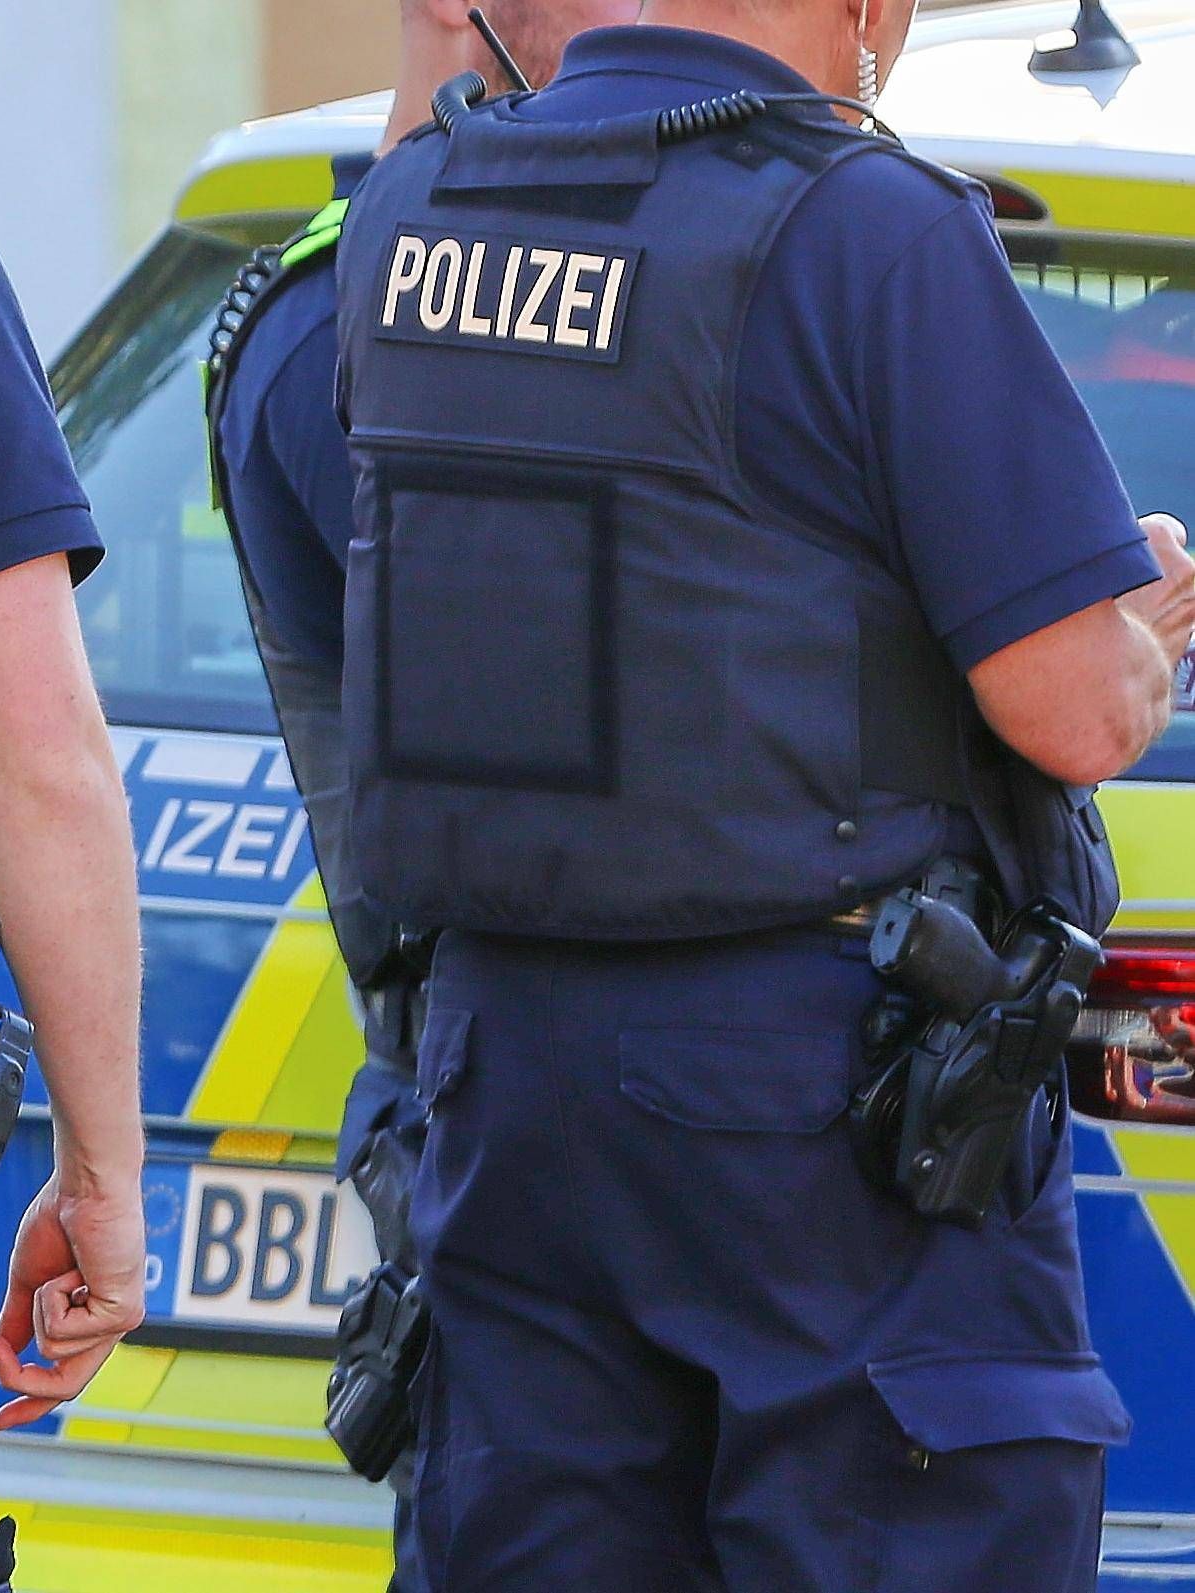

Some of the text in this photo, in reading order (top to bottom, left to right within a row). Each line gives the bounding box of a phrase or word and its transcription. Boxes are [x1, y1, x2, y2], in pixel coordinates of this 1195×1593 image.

[381, 234, 625, 350] POLIZEI
[127, 796, 308, 880] IZEI
[191, 1184, 359, 1307] BBL
